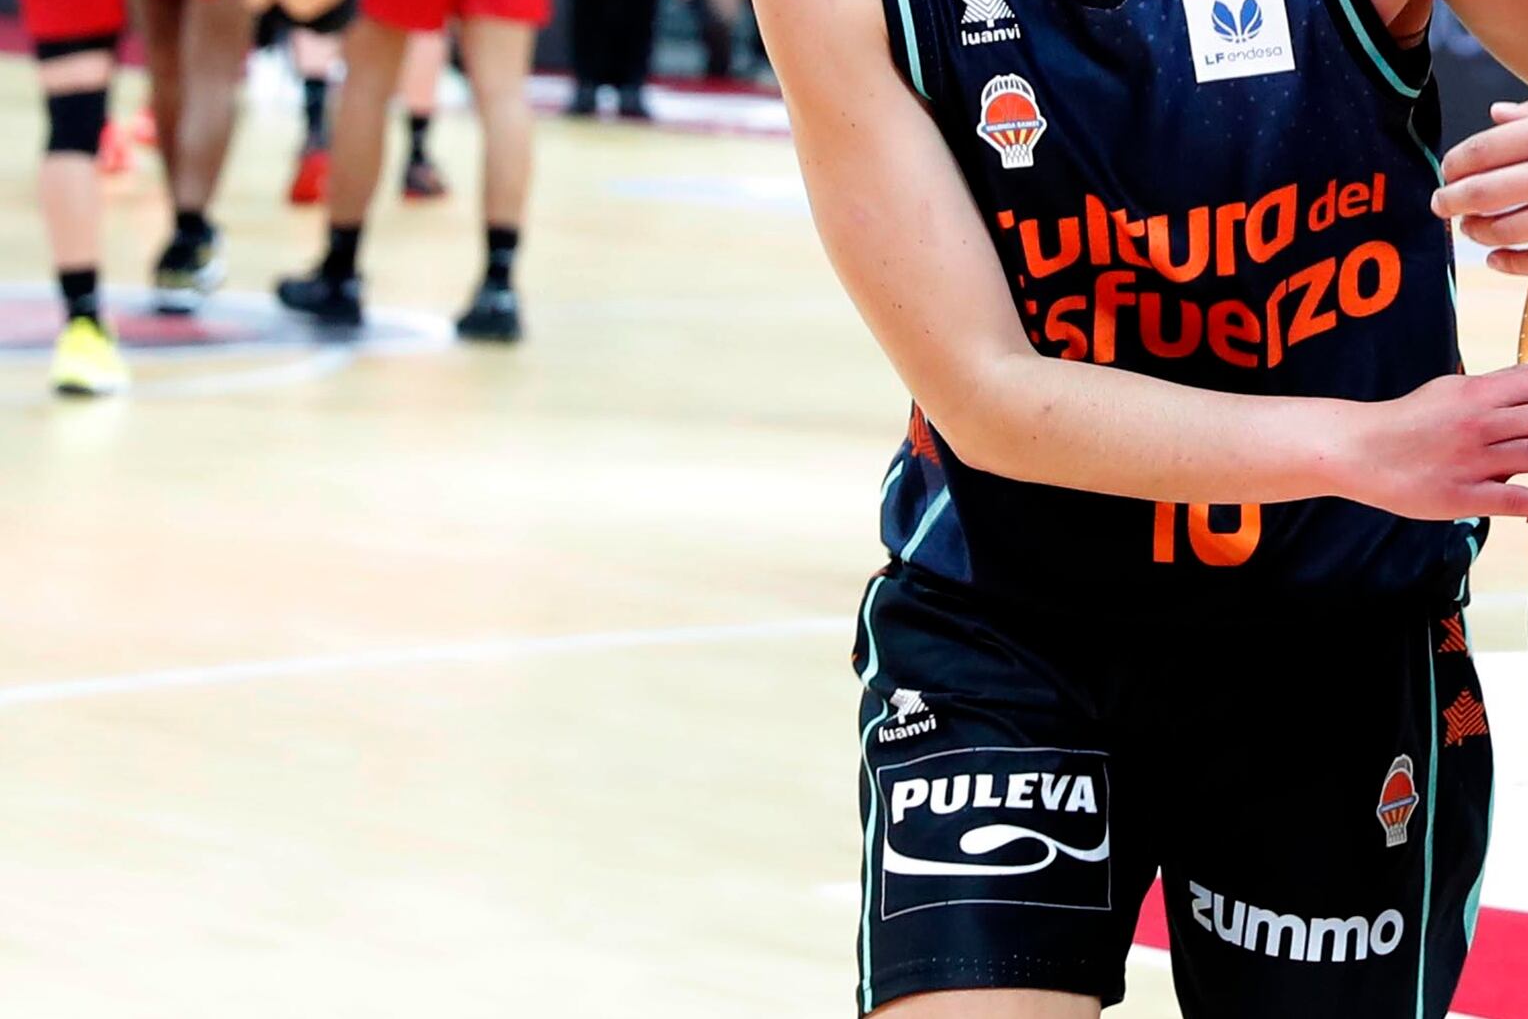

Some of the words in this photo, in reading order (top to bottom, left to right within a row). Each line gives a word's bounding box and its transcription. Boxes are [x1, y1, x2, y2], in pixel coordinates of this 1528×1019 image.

[961, 23, 1021, 46] luanvi
[1205, 53, 1225, 65] LF
[997, 184, 1298, 283] ultura
[1308, 174, 1386, 233] del
[1018, 240, 1401, 369] sfuerzo
[878, 714, 937, 743] luanvi
[891, 773, 1098, 823] PULEVA
[1190, 880, 1404, 962] zummo
